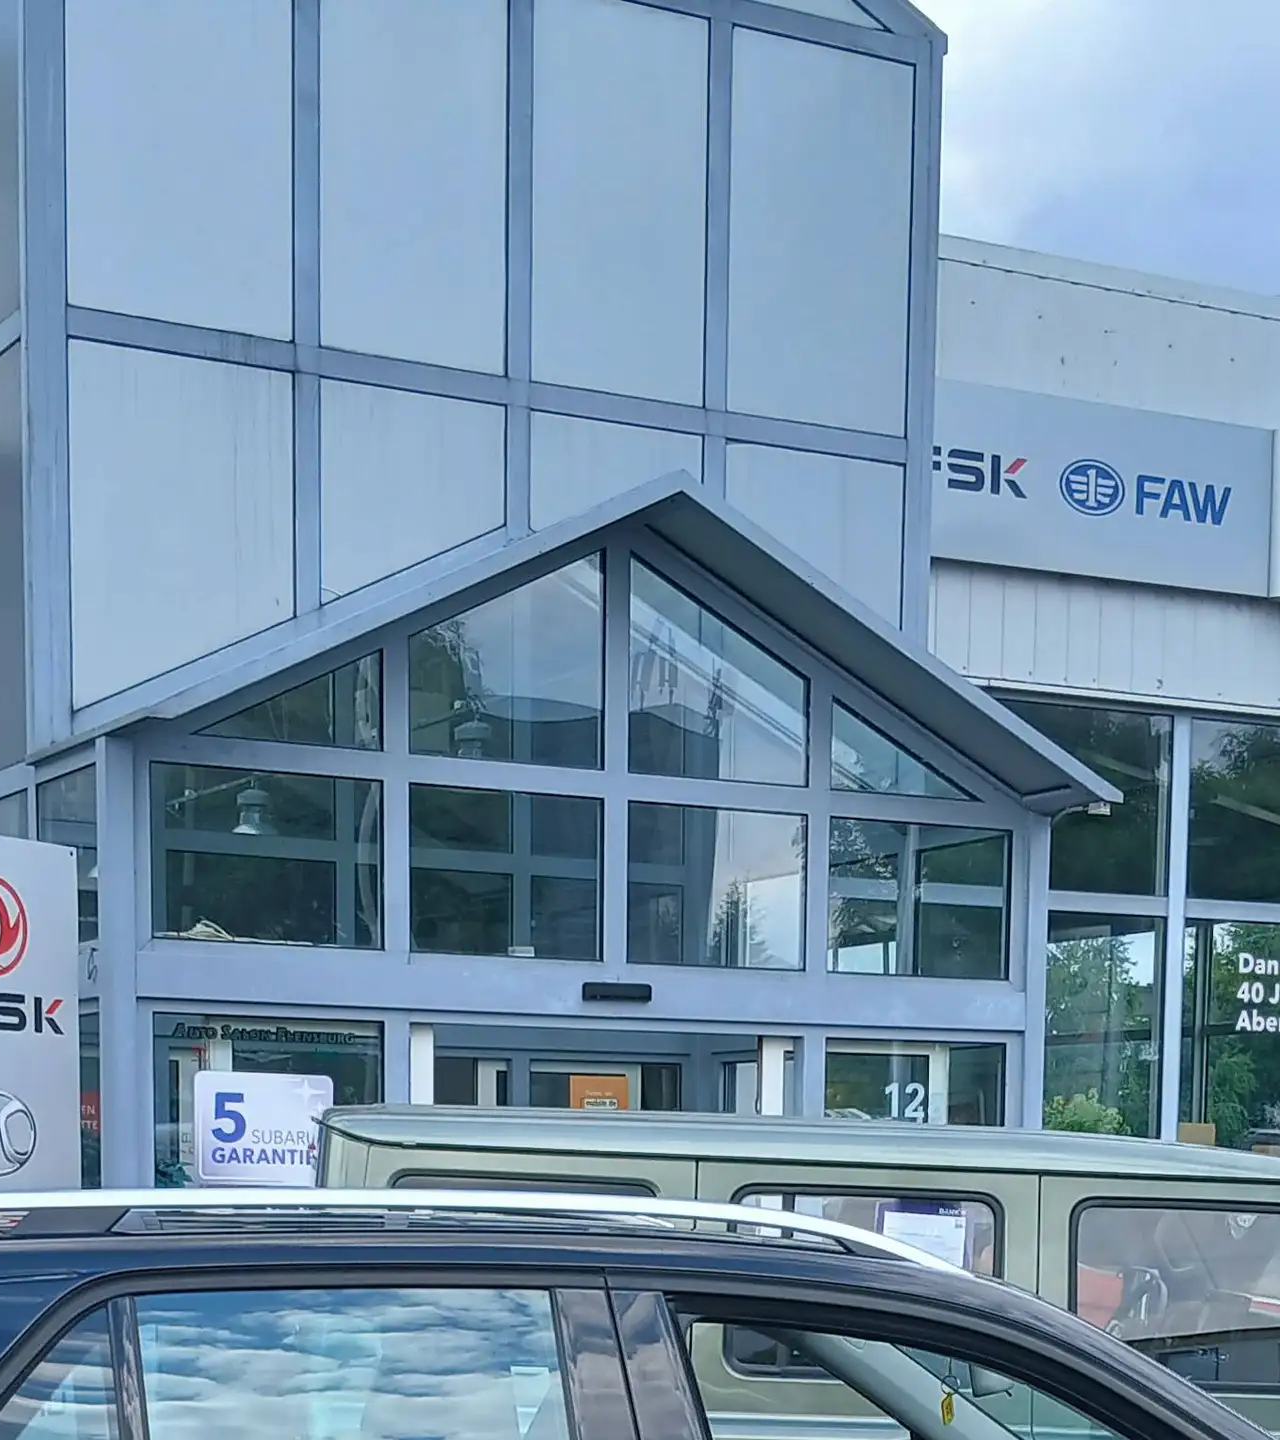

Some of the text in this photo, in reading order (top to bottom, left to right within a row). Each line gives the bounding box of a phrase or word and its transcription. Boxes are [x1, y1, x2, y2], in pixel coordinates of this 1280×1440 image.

[932, 446, 1028, 499] SK
[1136, 474, 1232, 525] FAW
[1236, 982, 1264, 1004] 40
[211, 1092, 246, 1143] 5
[885, 1082, 924, 1118] 12
